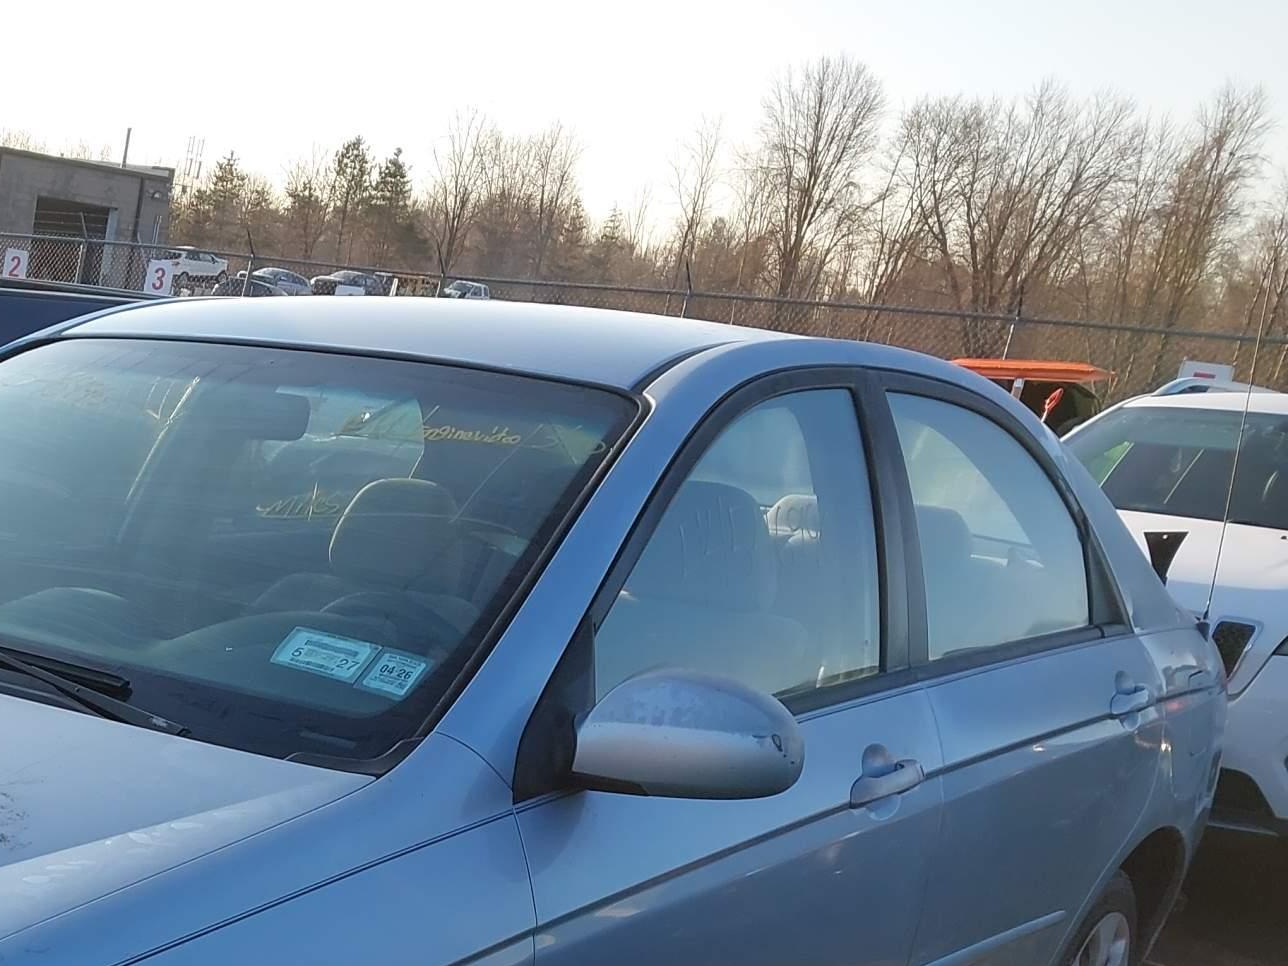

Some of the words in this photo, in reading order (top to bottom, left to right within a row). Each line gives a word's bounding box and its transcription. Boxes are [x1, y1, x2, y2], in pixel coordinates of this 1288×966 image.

[8, 255, 21, 278] 2
[151, 267, 167, 291] 3
[335, 658, 361, 671] 27
